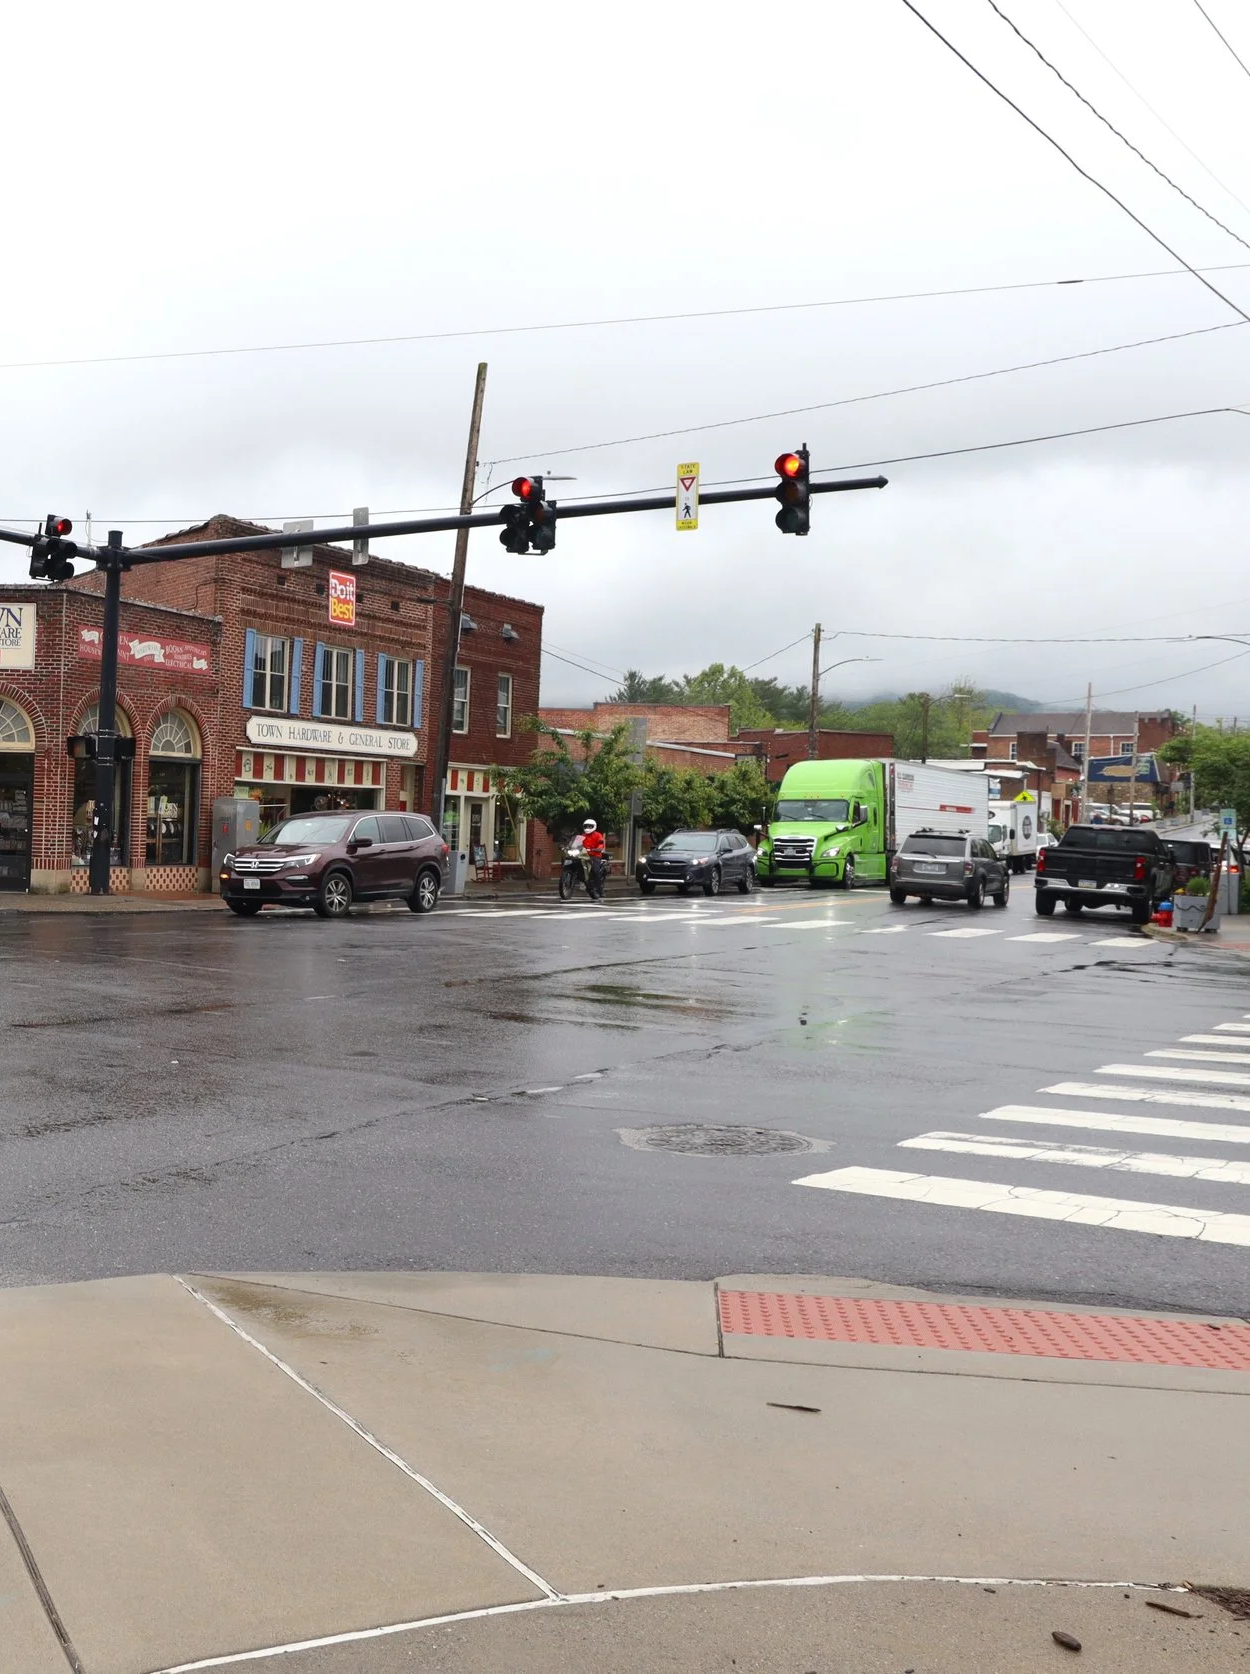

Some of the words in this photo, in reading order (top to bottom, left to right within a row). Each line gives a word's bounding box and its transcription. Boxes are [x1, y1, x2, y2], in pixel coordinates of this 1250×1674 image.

[331, 598, 353, 619] Best
[165, 643, 184, 655] BOOKS
[256, 723, 283, 738] TOWN
[288, 726, 332, 743] HARDWARE
[337, 731, 344, 745] &
[349, 732, 384, 748] GENERAL
[388, 736, 411, 750] STORE
